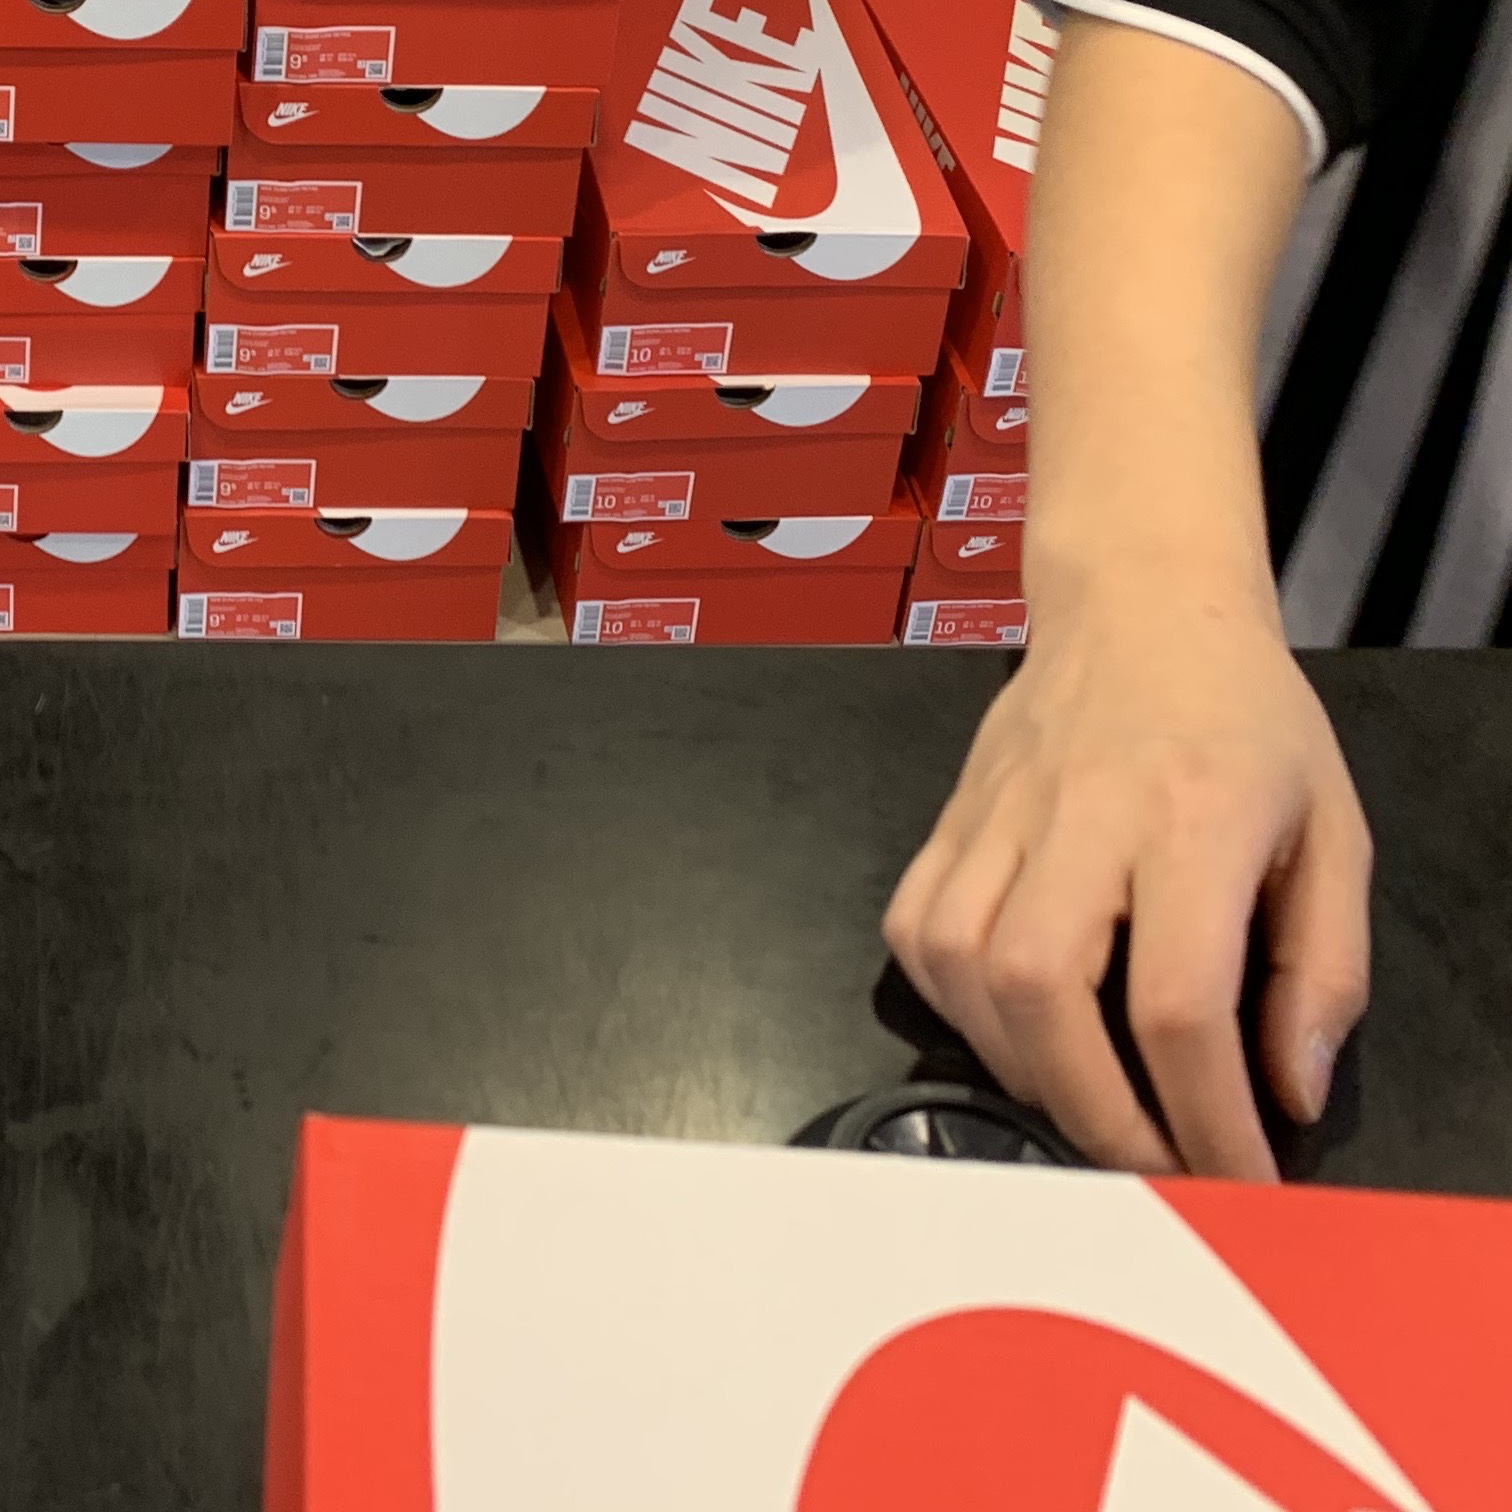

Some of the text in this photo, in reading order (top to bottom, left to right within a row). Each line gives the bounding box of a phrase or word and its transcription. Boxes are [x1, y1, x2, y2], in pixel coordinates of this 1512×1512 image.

[630, 348, 651, 363] 10
[595, 495, 616, 509] 10
[970, 495, 993, 509] 10
[603, 620, 623, 635] 10
[935, 620, 956, 635] 10
